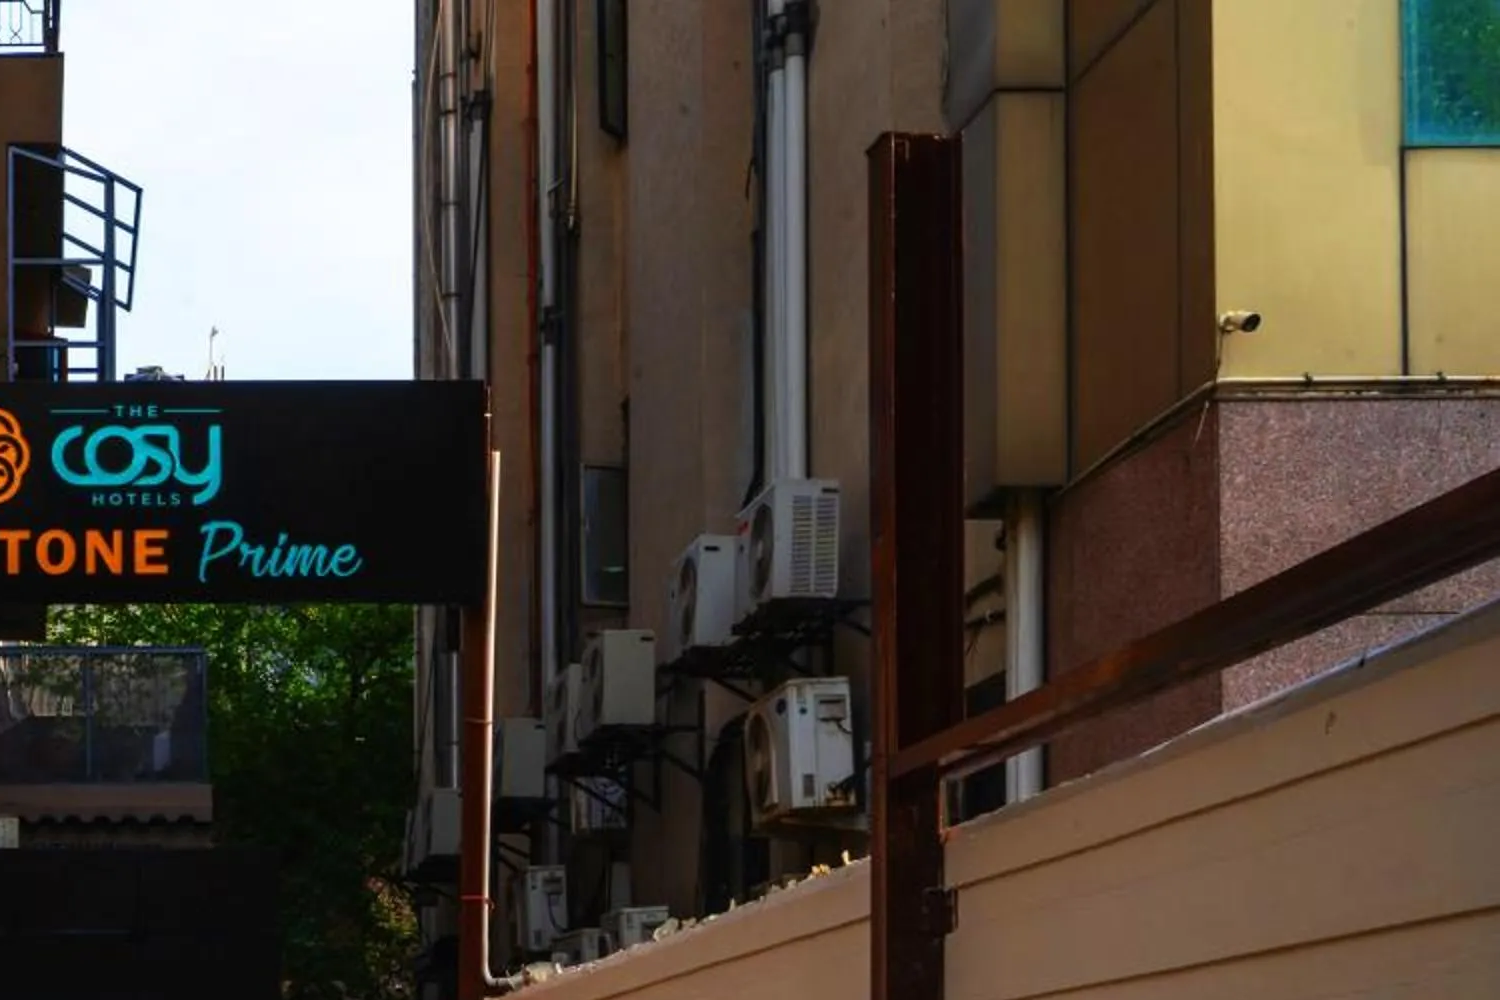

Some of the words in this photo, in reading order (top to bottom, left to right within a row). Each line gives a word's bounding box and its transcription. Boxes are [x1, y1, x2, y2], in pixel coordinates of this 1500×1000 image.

[113, 405, 159, 417] THE
[91, 493, 182, 506] HOTELS
[198, 520, 363, 584] Prime
